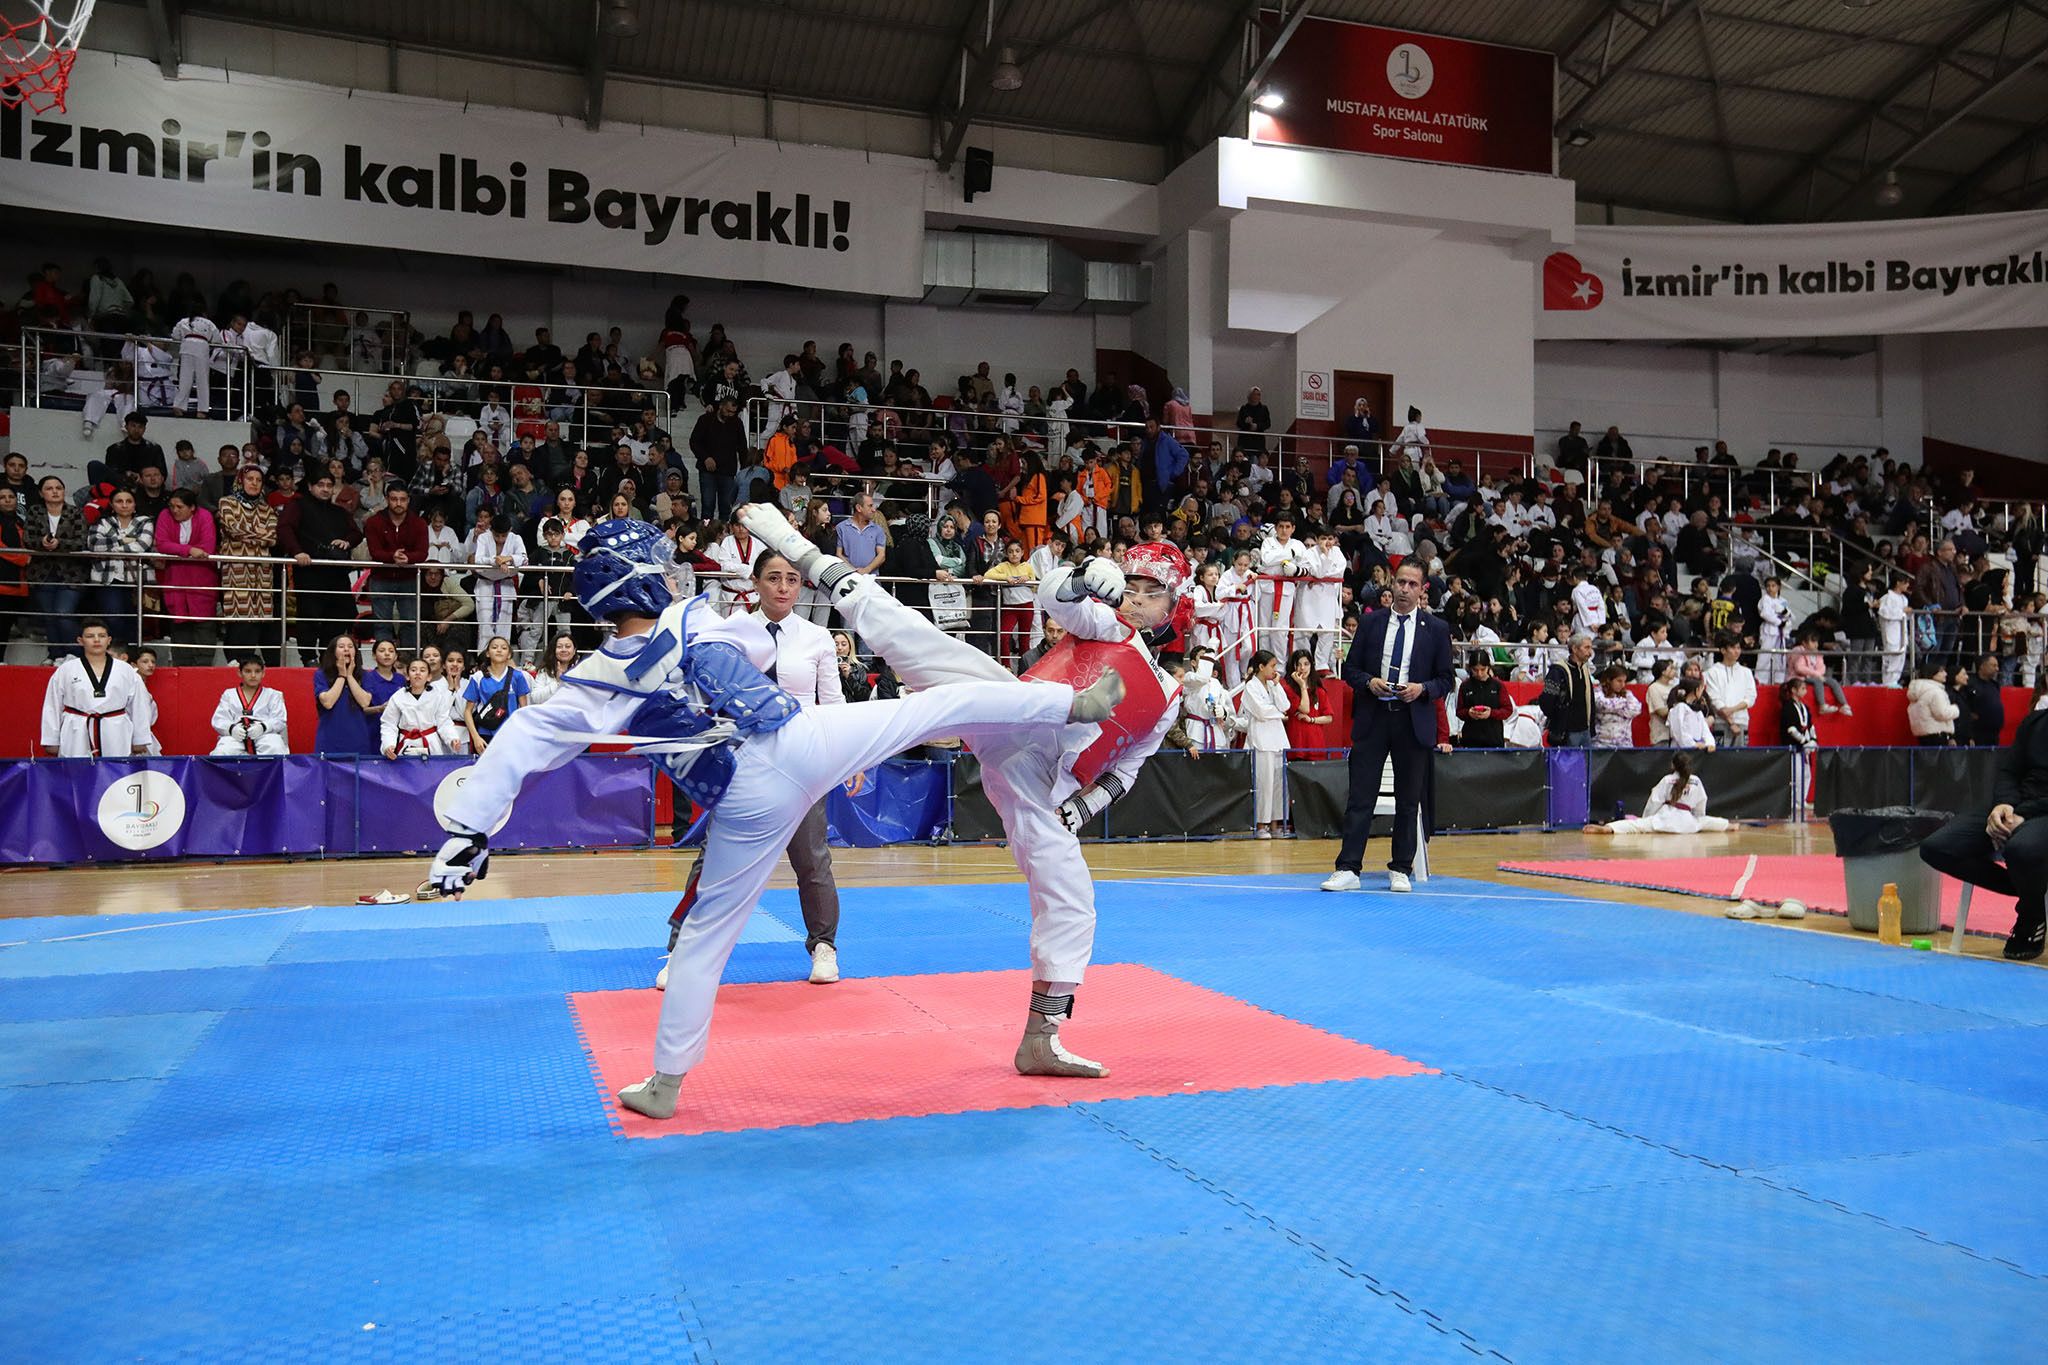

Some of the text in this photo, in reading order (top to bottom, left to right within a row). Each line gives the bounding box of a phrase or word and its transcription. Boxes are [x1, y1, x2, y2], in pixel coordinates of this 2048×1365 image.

[1326, 98, 1488, 132] MUSTAFA KEMAL ATATÜRK
[1373, 123, 1443, 145] Spor Salonu
[344, 144, 527, 218] kalbi
[547, 167, 850, 252] Bayraklı!
[1622, 257, 1768, 297] İzmir'in
[1778, 260, 1875, 294] kalbi
